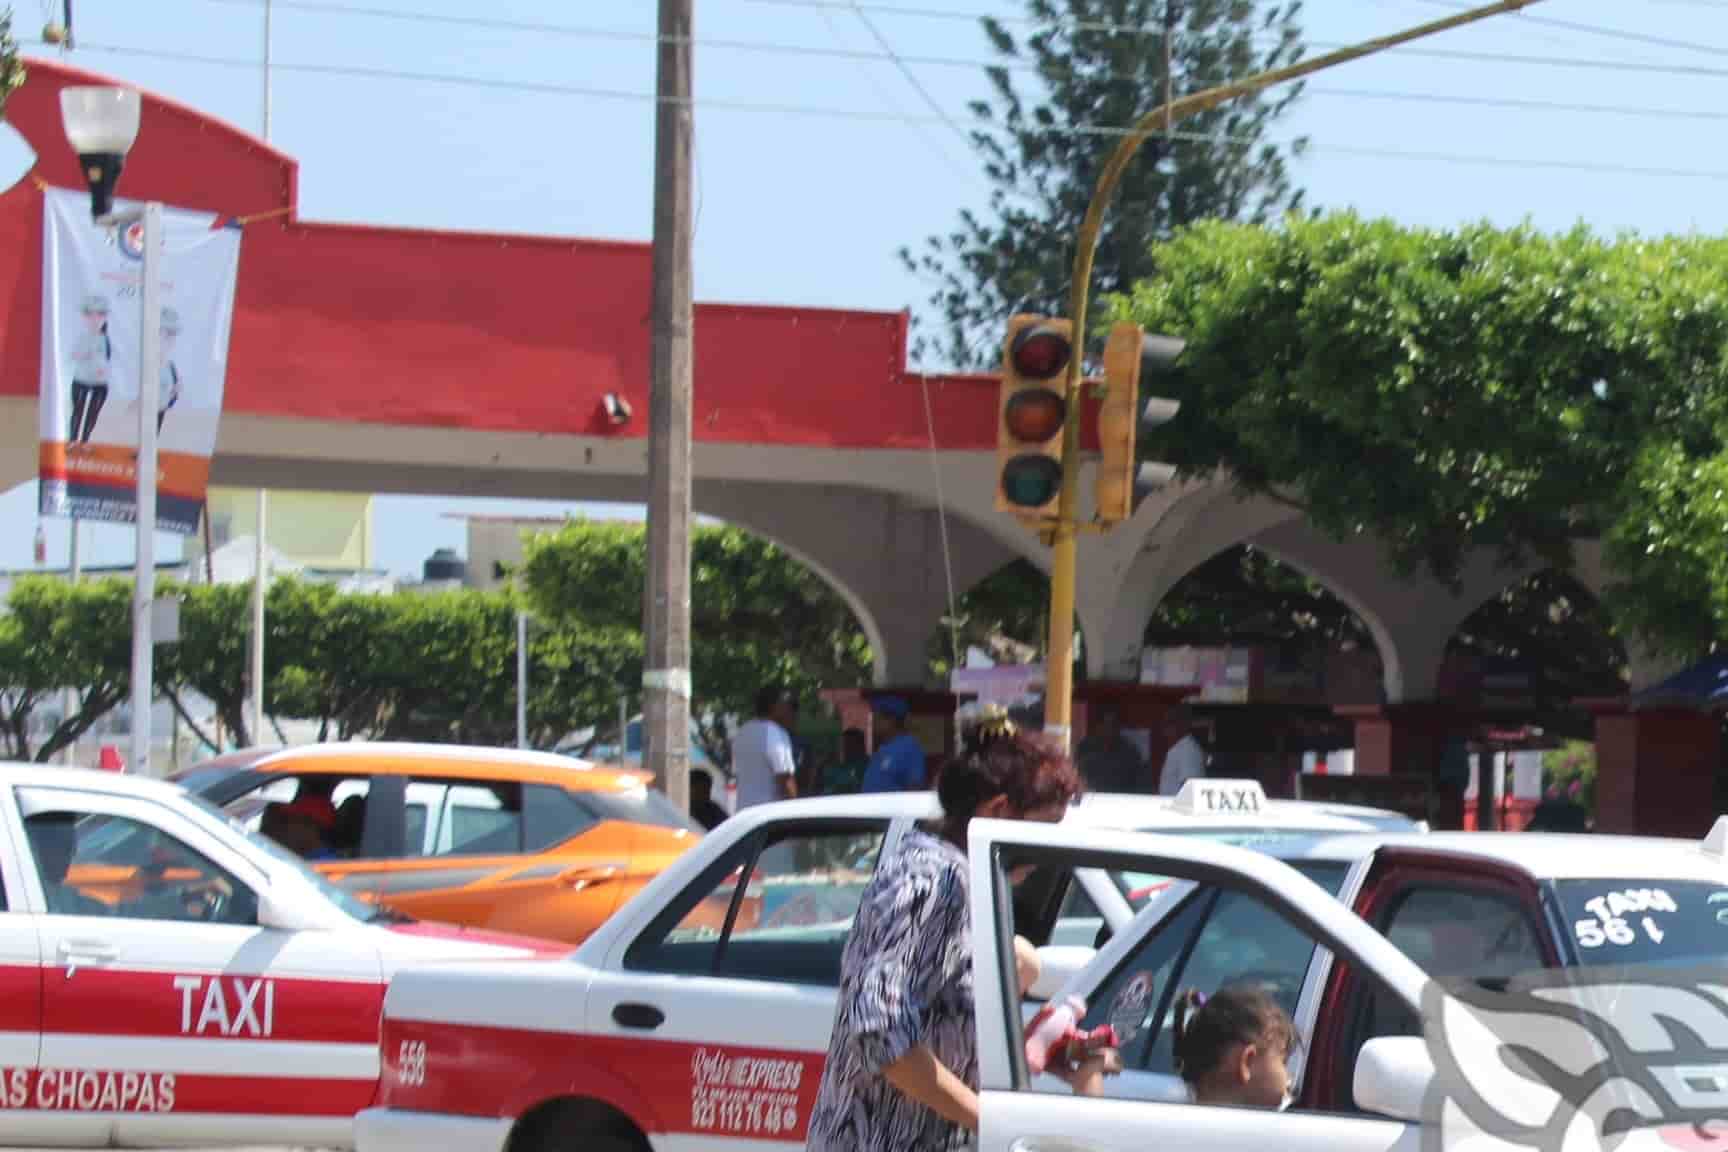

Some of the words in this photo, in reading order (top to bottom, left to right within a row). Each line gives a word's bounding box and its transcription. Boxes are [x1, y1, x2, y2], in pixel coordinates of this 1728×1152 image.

[1200, 788, 1260, 811] TAXI
[173, 975, 275, 1037] TAXI
[733, 1057, 804, 1090] EXPRESS
[36, 1069, 177, 1113] CHOAPAS
[720, 1100, 743, 1131] 112
